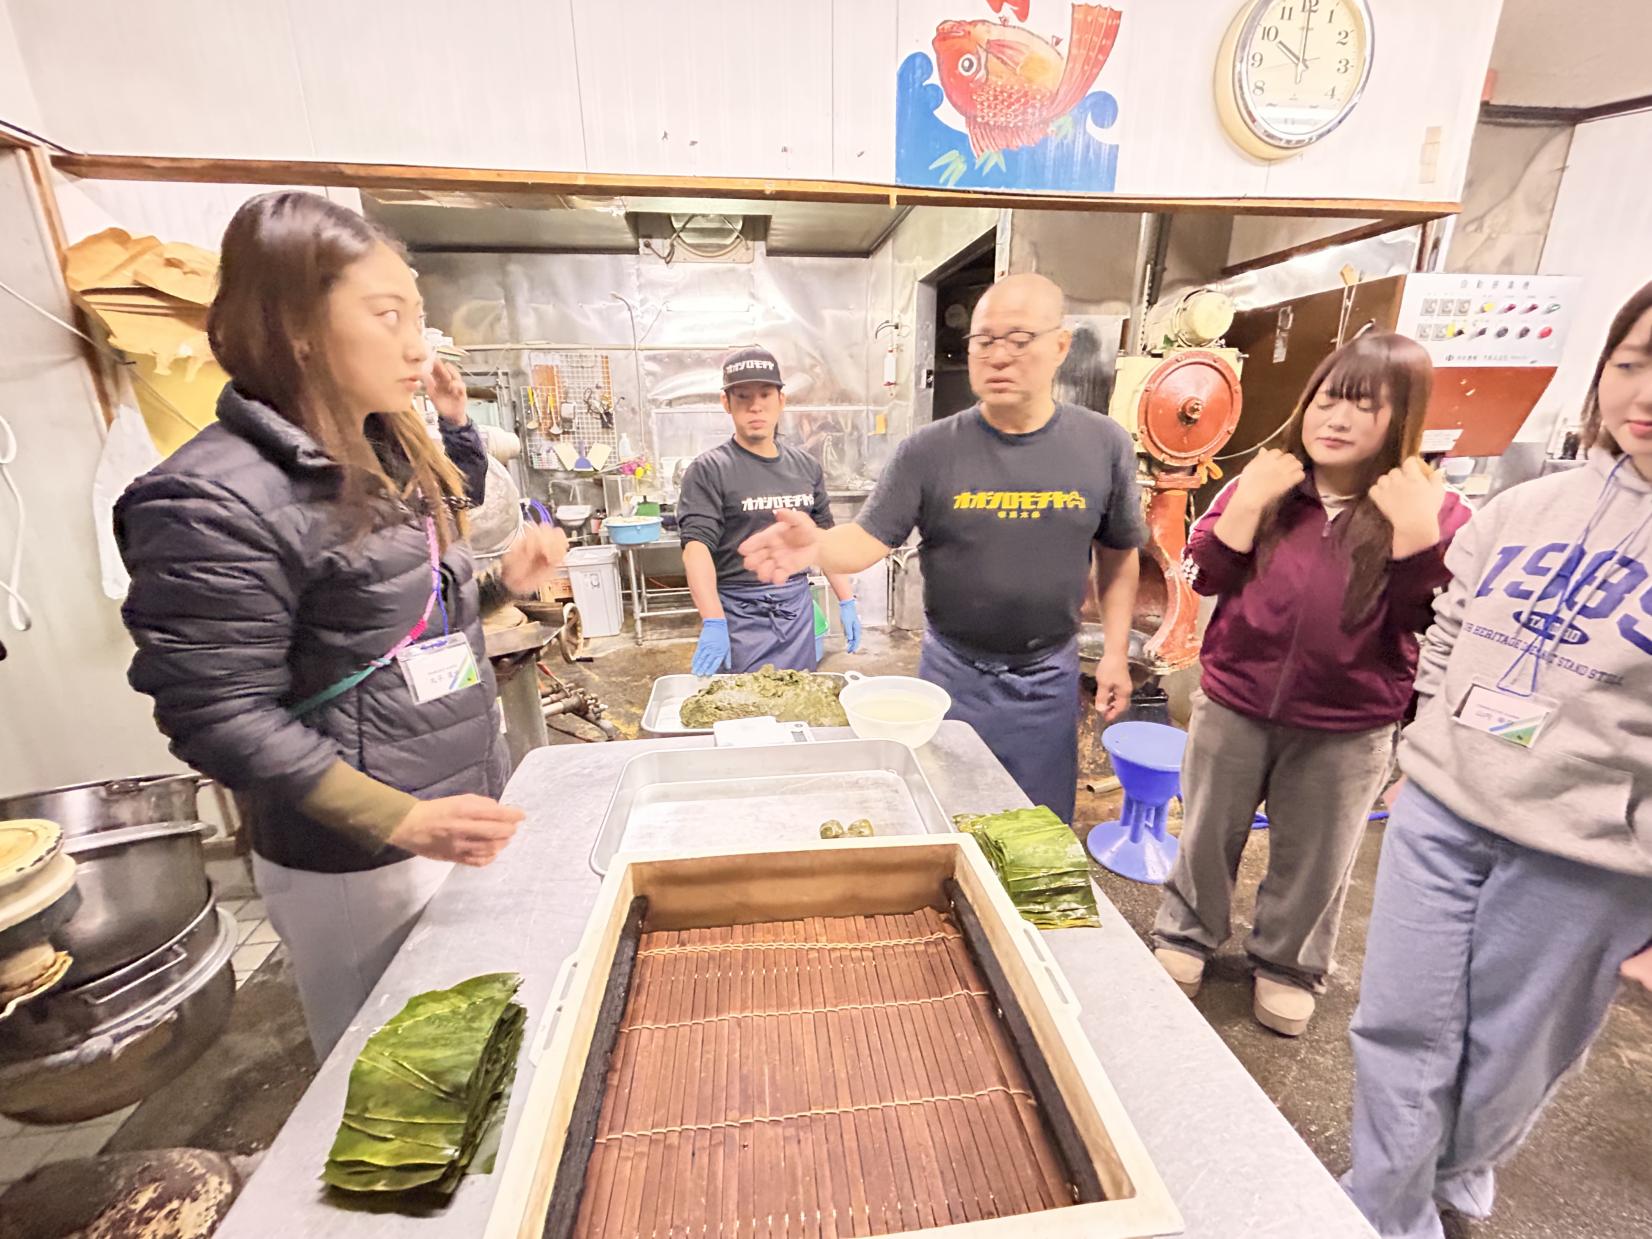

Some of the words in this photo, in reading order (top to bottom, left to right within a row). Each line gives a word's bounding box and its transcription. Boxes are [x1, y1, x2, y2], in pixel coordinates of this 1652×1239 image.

[1280, 6, 1294, 21] 11
[1327, 9, 1335, 24] 1
[1261, 25, 1279, 42] 10
[1336, 30, 1349, 46] 2
[1251, 52, 1264, 68] 9
[1336, 58, 1350, 74] 3
[1252, 80, 1265, 96] 8
